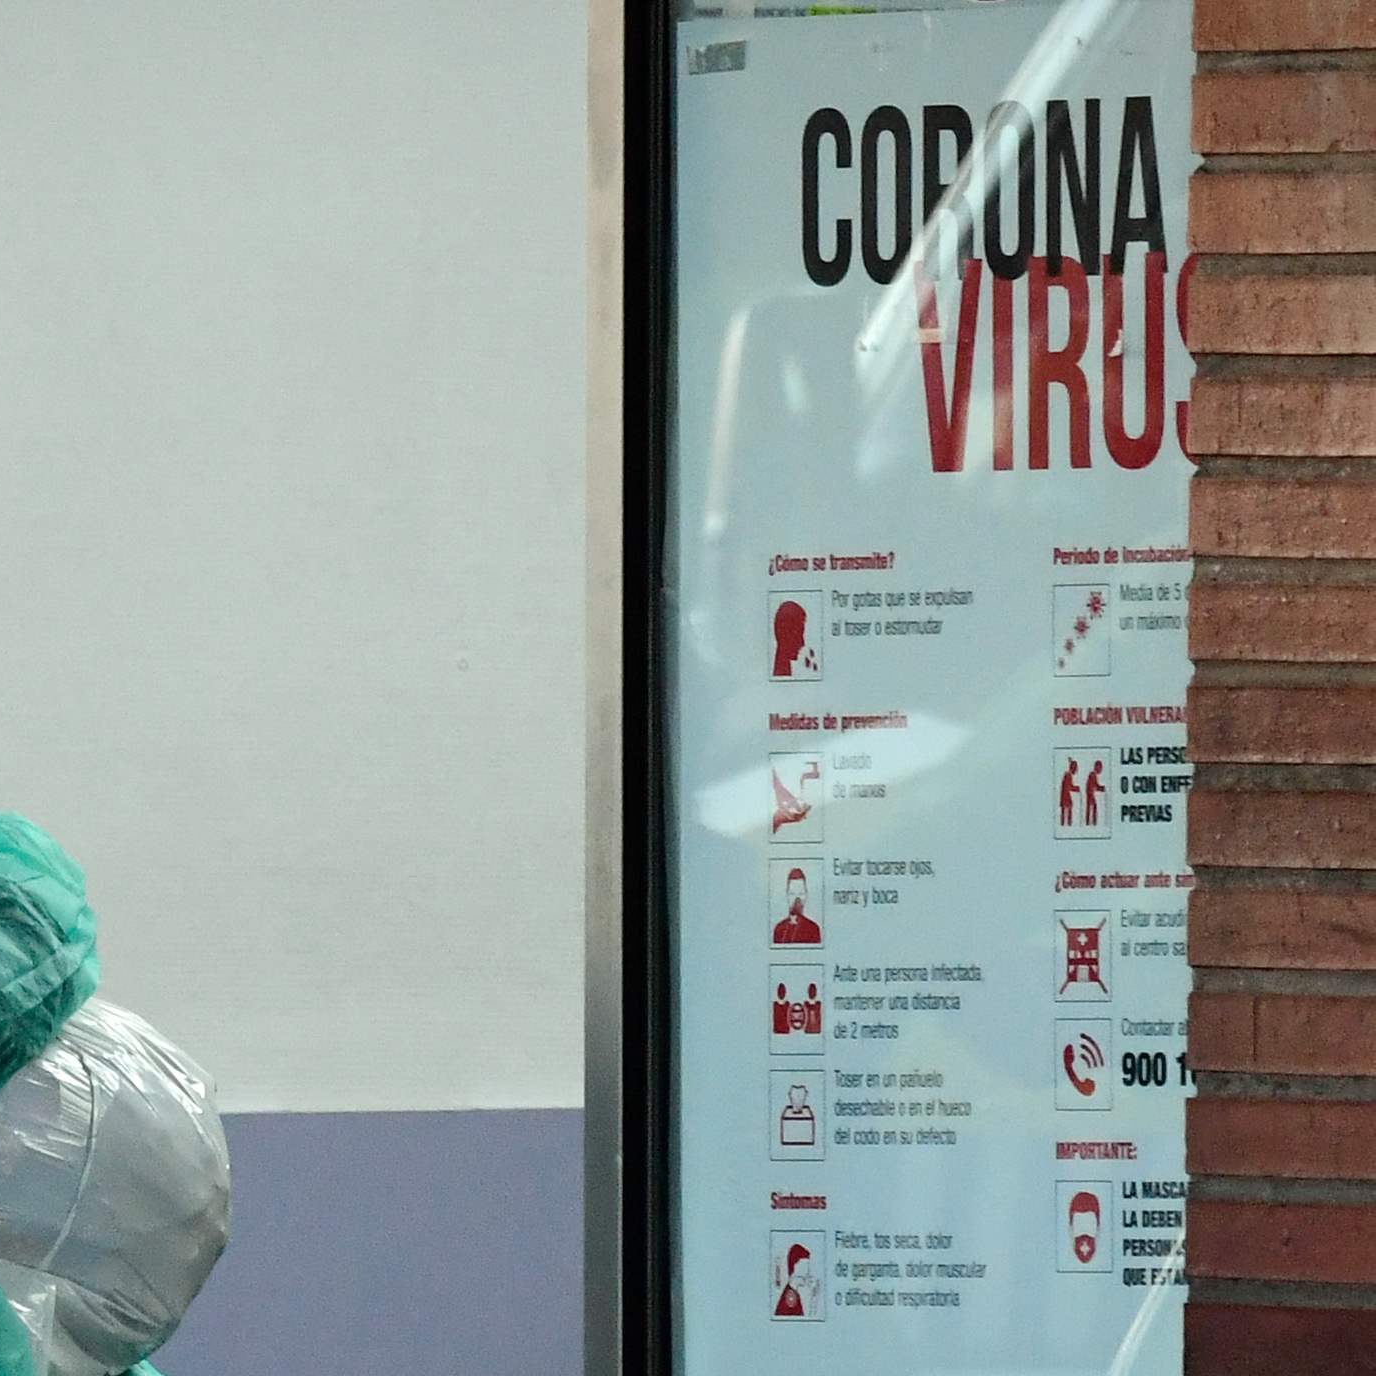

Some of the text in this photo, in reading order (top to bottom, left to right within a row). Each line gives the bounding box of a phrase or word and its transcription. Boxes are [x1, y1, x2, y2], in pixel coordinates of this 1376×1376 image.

[802, 96, 1169, 287] CORONA
[812, 557, 826, 571] se
[830, 552, 895, 571] transmite?
[1104, 547, 1119, 564] de
[831, 589, 974, 610] Por gotas que se expulsan
[1120, 583, 1153, 601] Media
[1157, 583, 1171, 601] de
[832, 618, 943, 636] al toser o estornudar
[768, 711, 908, 731] Medidas de prevención
[1053, 704, 1187, 725] POBLACIÓN VULNERA
[1121, 747, 1143, 765] LAS
[833, 781, 846, 798] de
[1121, 776, 1129, 794] O
[1132, 775, 1156, 793] CON
[1121, 804, 1172, 822] PREVIAS
[833, 858, 862, 876] Evitar
[866, 860, 906, 876] tocarse
[833, 888, 898, 907] nariz y boca
[1120, 909, 1150, 927] Evitar
[1134, 940, 1169, 956] centro
[833, 964, 857, 982] Ante
[861, 967, 881, 982] una
[884, 967, 928, 984] persona
[833, 992, 961, 1010] mantener una distancia
[833, 1022, 899, 1039] de 2 metros
[1122, 1052, 1167, 1087] 900
[834, 1070, 944, 1091] Toser en un pañuelo
[834, 1099, 972, 1116] desechable o en el hueco
[834, 1127, 957, 1145] del codo en su defecto
[1056, 1142, 1137, 1160] IMPORTANTE:
[1123, 1182, 1138, 1199] LA
[1123, 1210, 1183, 1228] LA DEBEN
[874, 1233, 890, 1248] tos
[925, 1231, 953, 1248] dolor
[835, 1260, 849, 1277] de
[906, 1261, 933, 1277] dolor
[936, 1261, 987, 1278] muscular
[1123, 1268, 1147, 1288] QUE
[835, 1288, 961, 1309] o dificultad respiratoria
